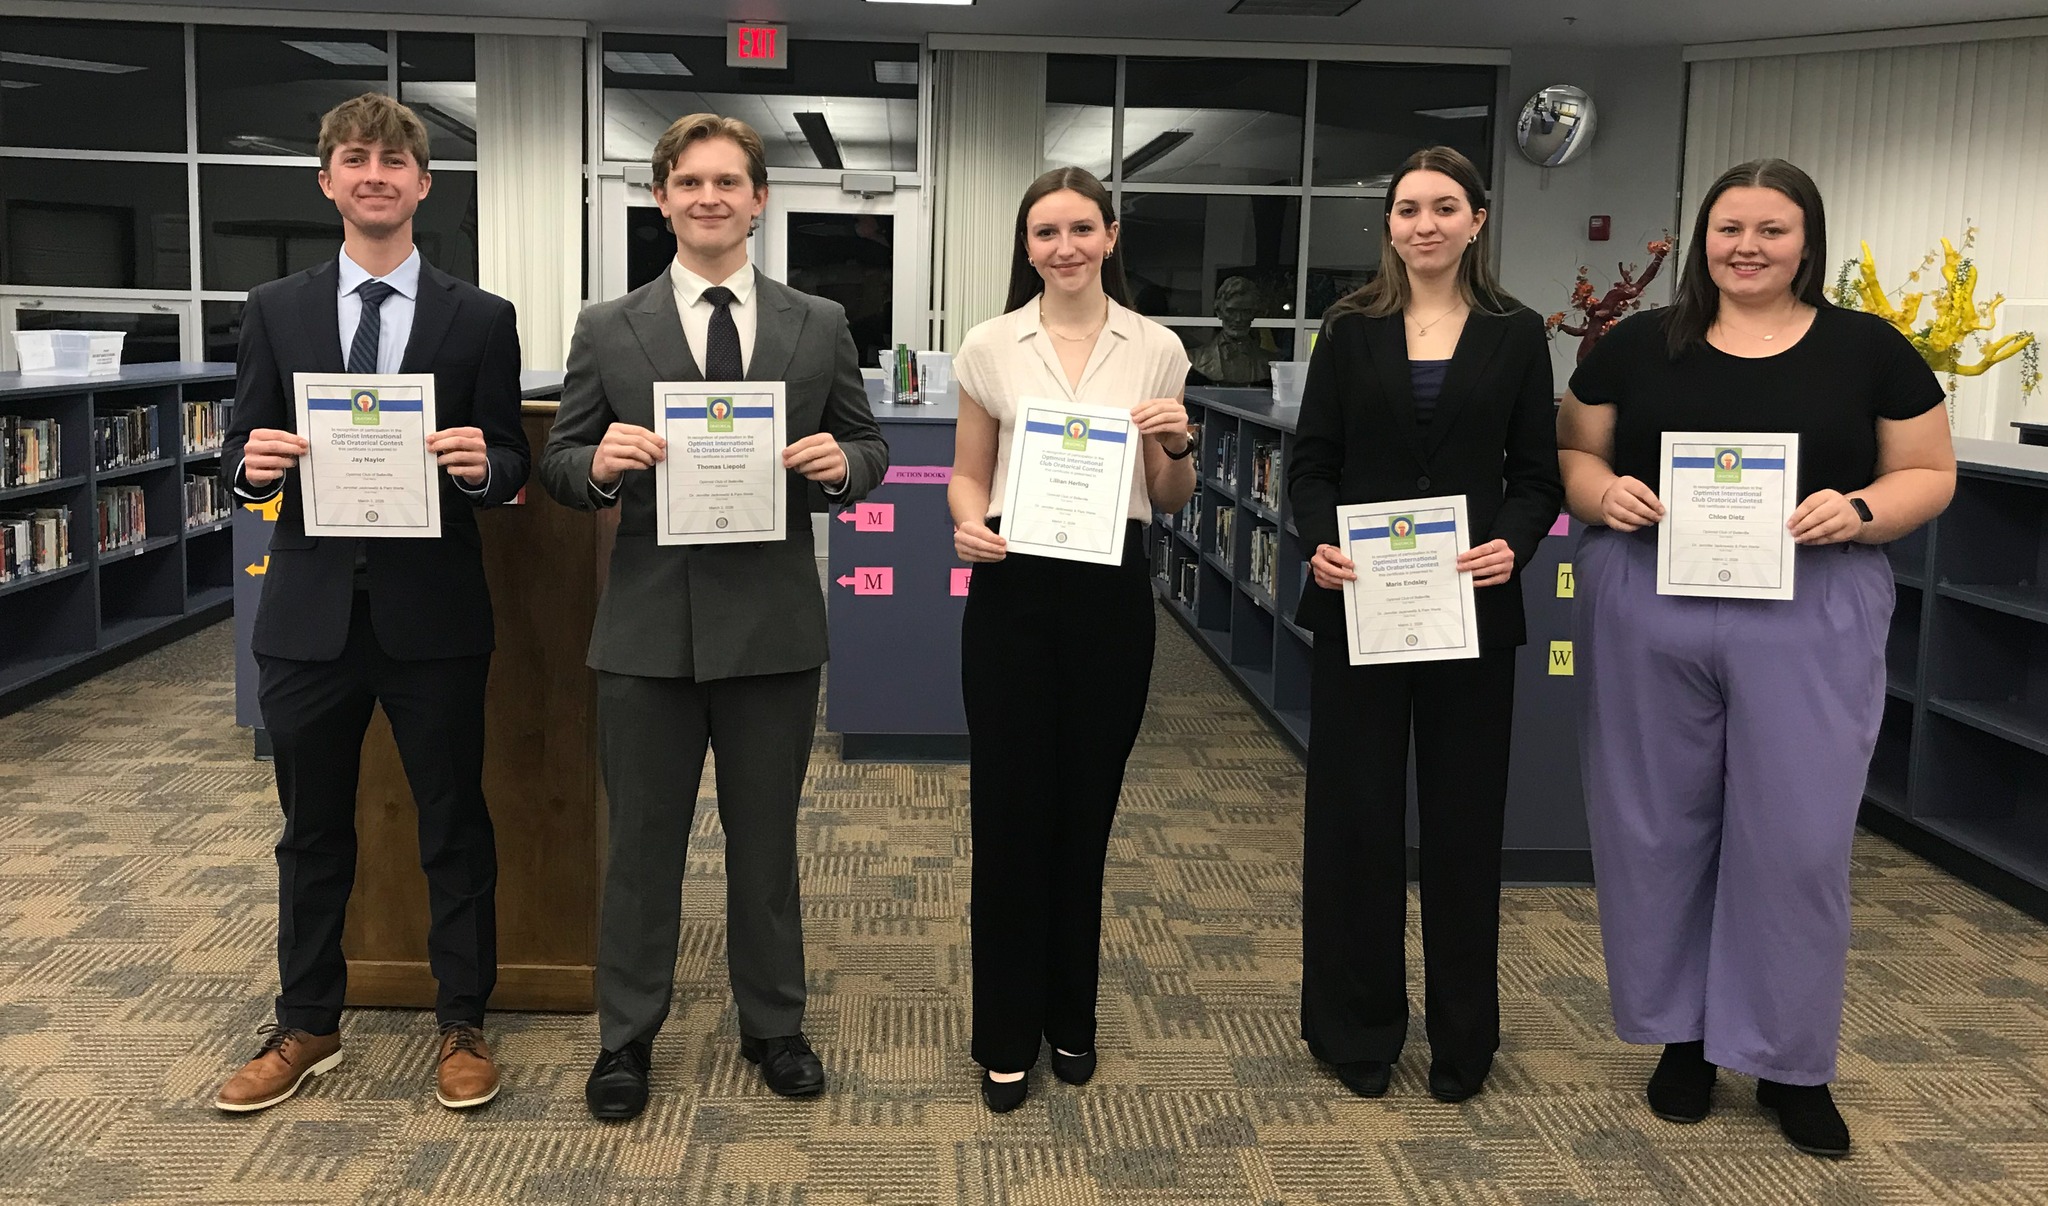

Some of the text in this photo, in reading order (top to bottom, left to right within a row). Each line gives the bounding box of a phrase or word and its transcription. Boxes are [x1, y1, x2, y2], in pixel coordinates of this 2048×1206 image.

[738, 27, 777, 59] EXIT
[1042, 454, 1103, 467] Optimist International
[1053, 462, 1081, 470] Oratorical
[896, 471, 922, 479] FICTION
[867, 511, 882, 525] M
[1372, 555, 1437, 566] Optimist International
[864, 573, 883, 590] M
[1560, 572, 1574, 590] T
[1552, 650, 1572, 666] W
